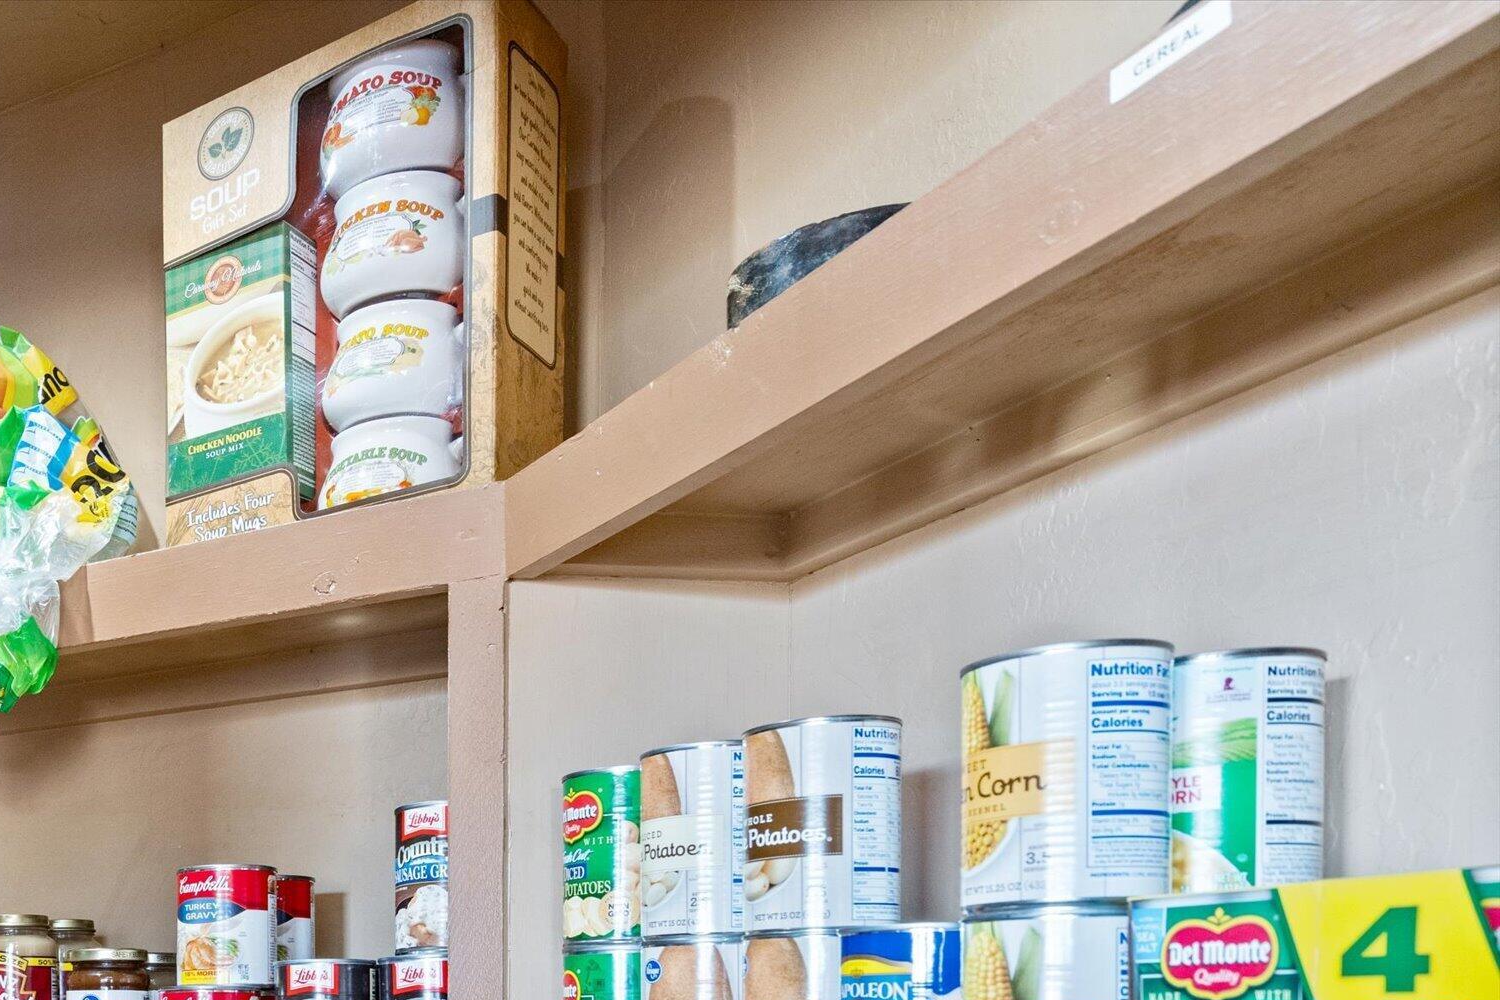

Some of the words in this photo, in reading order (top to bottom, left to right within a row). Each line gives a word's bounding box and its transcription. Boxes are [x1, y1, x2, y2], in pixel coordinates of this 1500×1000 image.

[389, 70, 443, 90] SOUP
[190, 168, 260, 221] SOUP
[202, 214, 225, 235] Gift
[231, 203, 249, 224] Set
[396, 199, 445, 222] SOUP
[221, 260, 263, 283] Naturals
[382, 323, 430, 341] SOUP
[187, 434, 224, 456] CHICKEN
[224, 425, 263, 446] NOODLE
[205, 446, 226, 459] SOUP
[228, 442, 245, 454] MIX
[388, 447, 428, 466] SOUP
[186, 501, 241, 527] Includes
[244, 490, 275, 516] Four
[194, 524, 229, 542] Soup
[231, 513, 268, 535] Mugs
[1091, 663, 1153, 677] Nutrition
[1267, 665, 1319, 678] Nutrition
[1091, 717, 1144, 729] Calories
[1266, 711, 1312, 723] Calories
[853, 727, 899, 740] Nutrition
[853, 765, 886, 776] Calories
[978, 770, 1044, 799] Corn
[408, 812, 441, 829] Libby's
[583, 835, 616, 847] WITH
[748, 826, 827, 850] Potatoes
[397, 836, 449, 868] Countr
[179, 874, 234, 895] Campbell's
[184, 902, 220, 912] TURKEY
[185, 911, 218, 921] GRAVY
[1169, 942, 1201, 967] Del
[1203, 937, 1272, 966] Monte
[1341, 904, 1431, 994] 4
[196, 969, 219, 978] MORE
[1192, 968, 1241, 985] Quality
